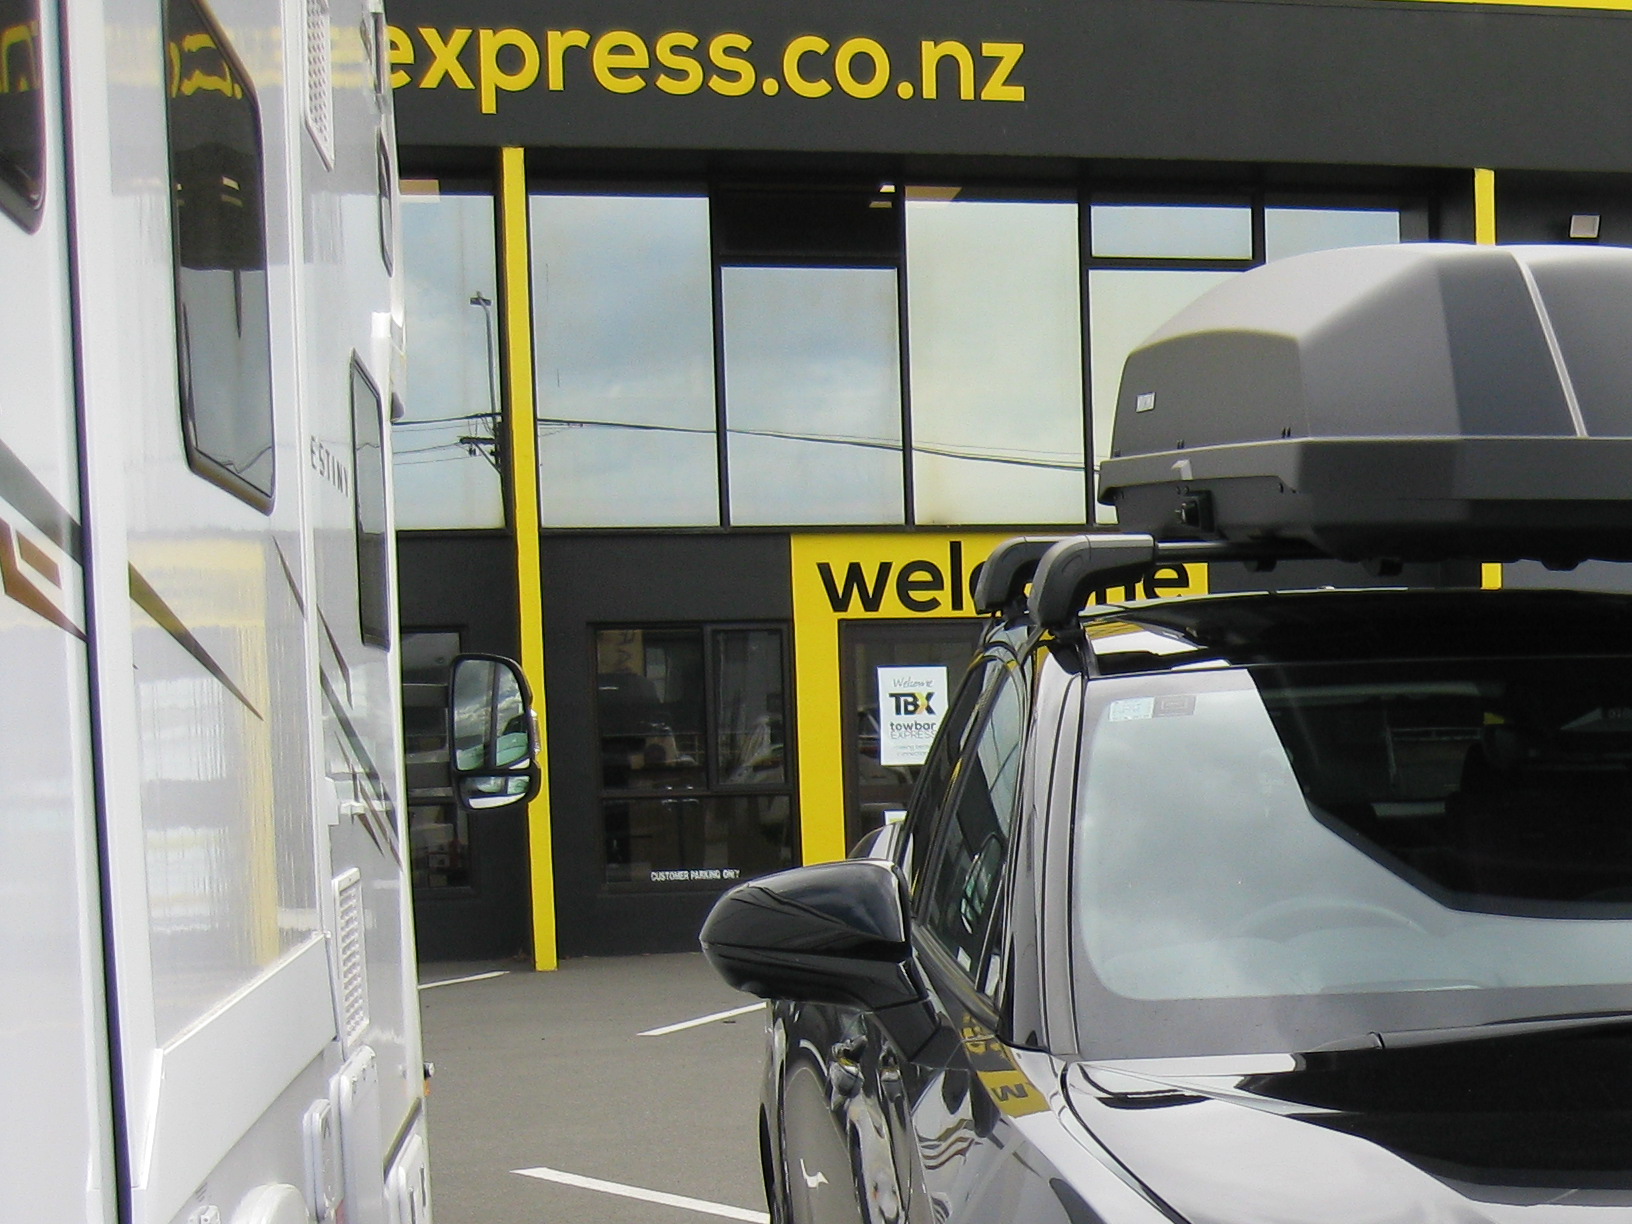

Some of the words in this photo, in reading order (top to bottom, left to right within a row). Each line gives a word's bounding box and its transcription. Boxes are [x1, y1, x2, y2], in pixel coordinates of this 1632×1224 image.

[386, 24, 1026, 115] express.co.nz
[816, 540, 1190, 613] wele
[888, 691, 936, 715] TBX
[890, 720, 936, 732] towbar
[650, 871, 689, 881] CUSTOMER
[690, 870, 721, 880] PARKING
